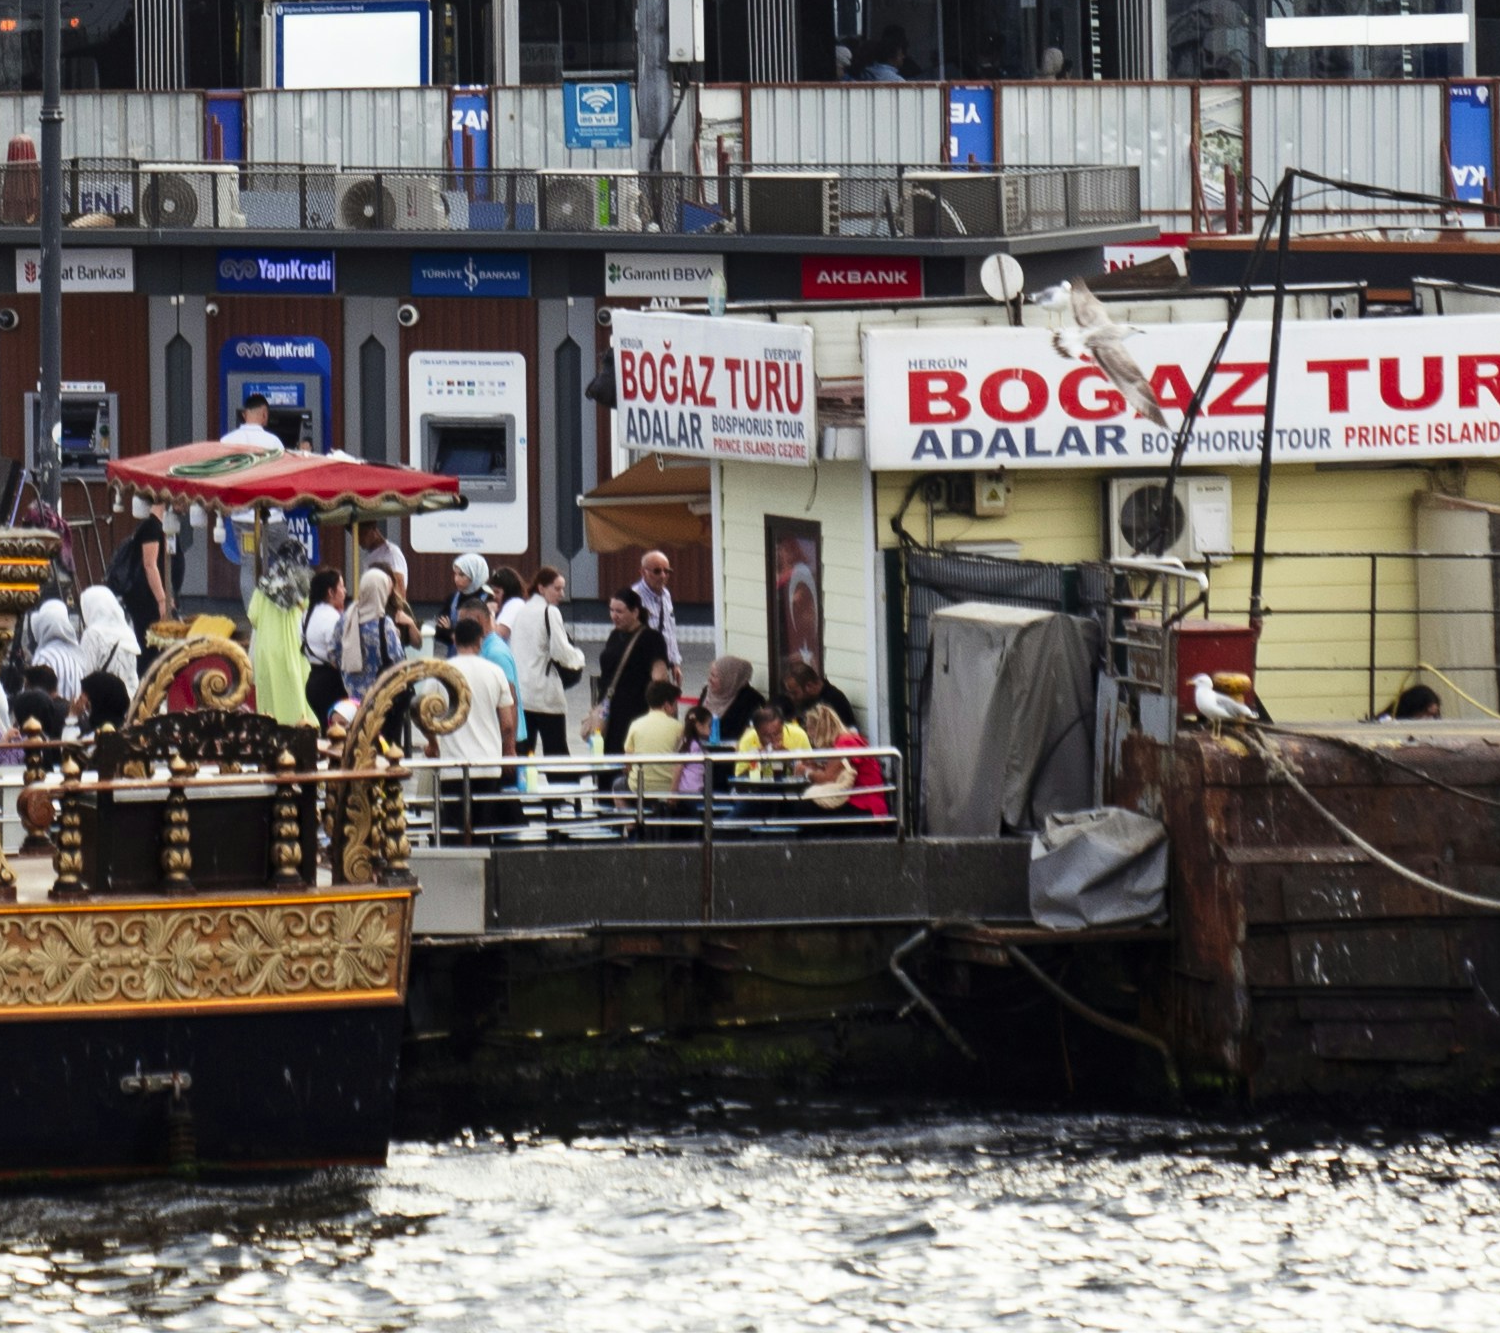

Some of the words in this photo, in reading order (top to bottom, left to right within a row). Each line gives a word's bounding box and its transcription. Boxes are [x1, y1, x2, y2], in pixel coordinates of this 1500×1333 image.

[77, 265, 127, 281] Bankası
[258, 258, 331, 283] YapıKredi
[421, 268, 462, 279] TÜRKİYE
[479, 270, 521, 280] BANKASI
[622, 265, 671, 282] Garanti
[673, 267, 715, 281] BBVA
[816, 270, 909, 285] AKBANK
[263, 342, 315, 360] YapıKredi
[764, 347, 802, 360] EVERYDAY
[620, 339, 717, 408] BOĞAZ
[908, 357, 968, 370] HERGÜN
[725, 357, 804, 415] TURU
[626, 406, 704, 450] ADALAR
[711, 413, 773, 437] BOSPHORUS
[776, 419, 805, 440] TOUR
[713, 437, 742, 454] PRINCE
[744, 439, 776, 457] ISLANDS
[777, 441, 806, 459] CEZİRE
[911, 424, 1129, 461] ADALAR
[1141, 428, 1264, 454] BOSPHORUS
[1276, 427, 1331, 450] TOUR
[1344, 424, 1420, 448] PRINCE
